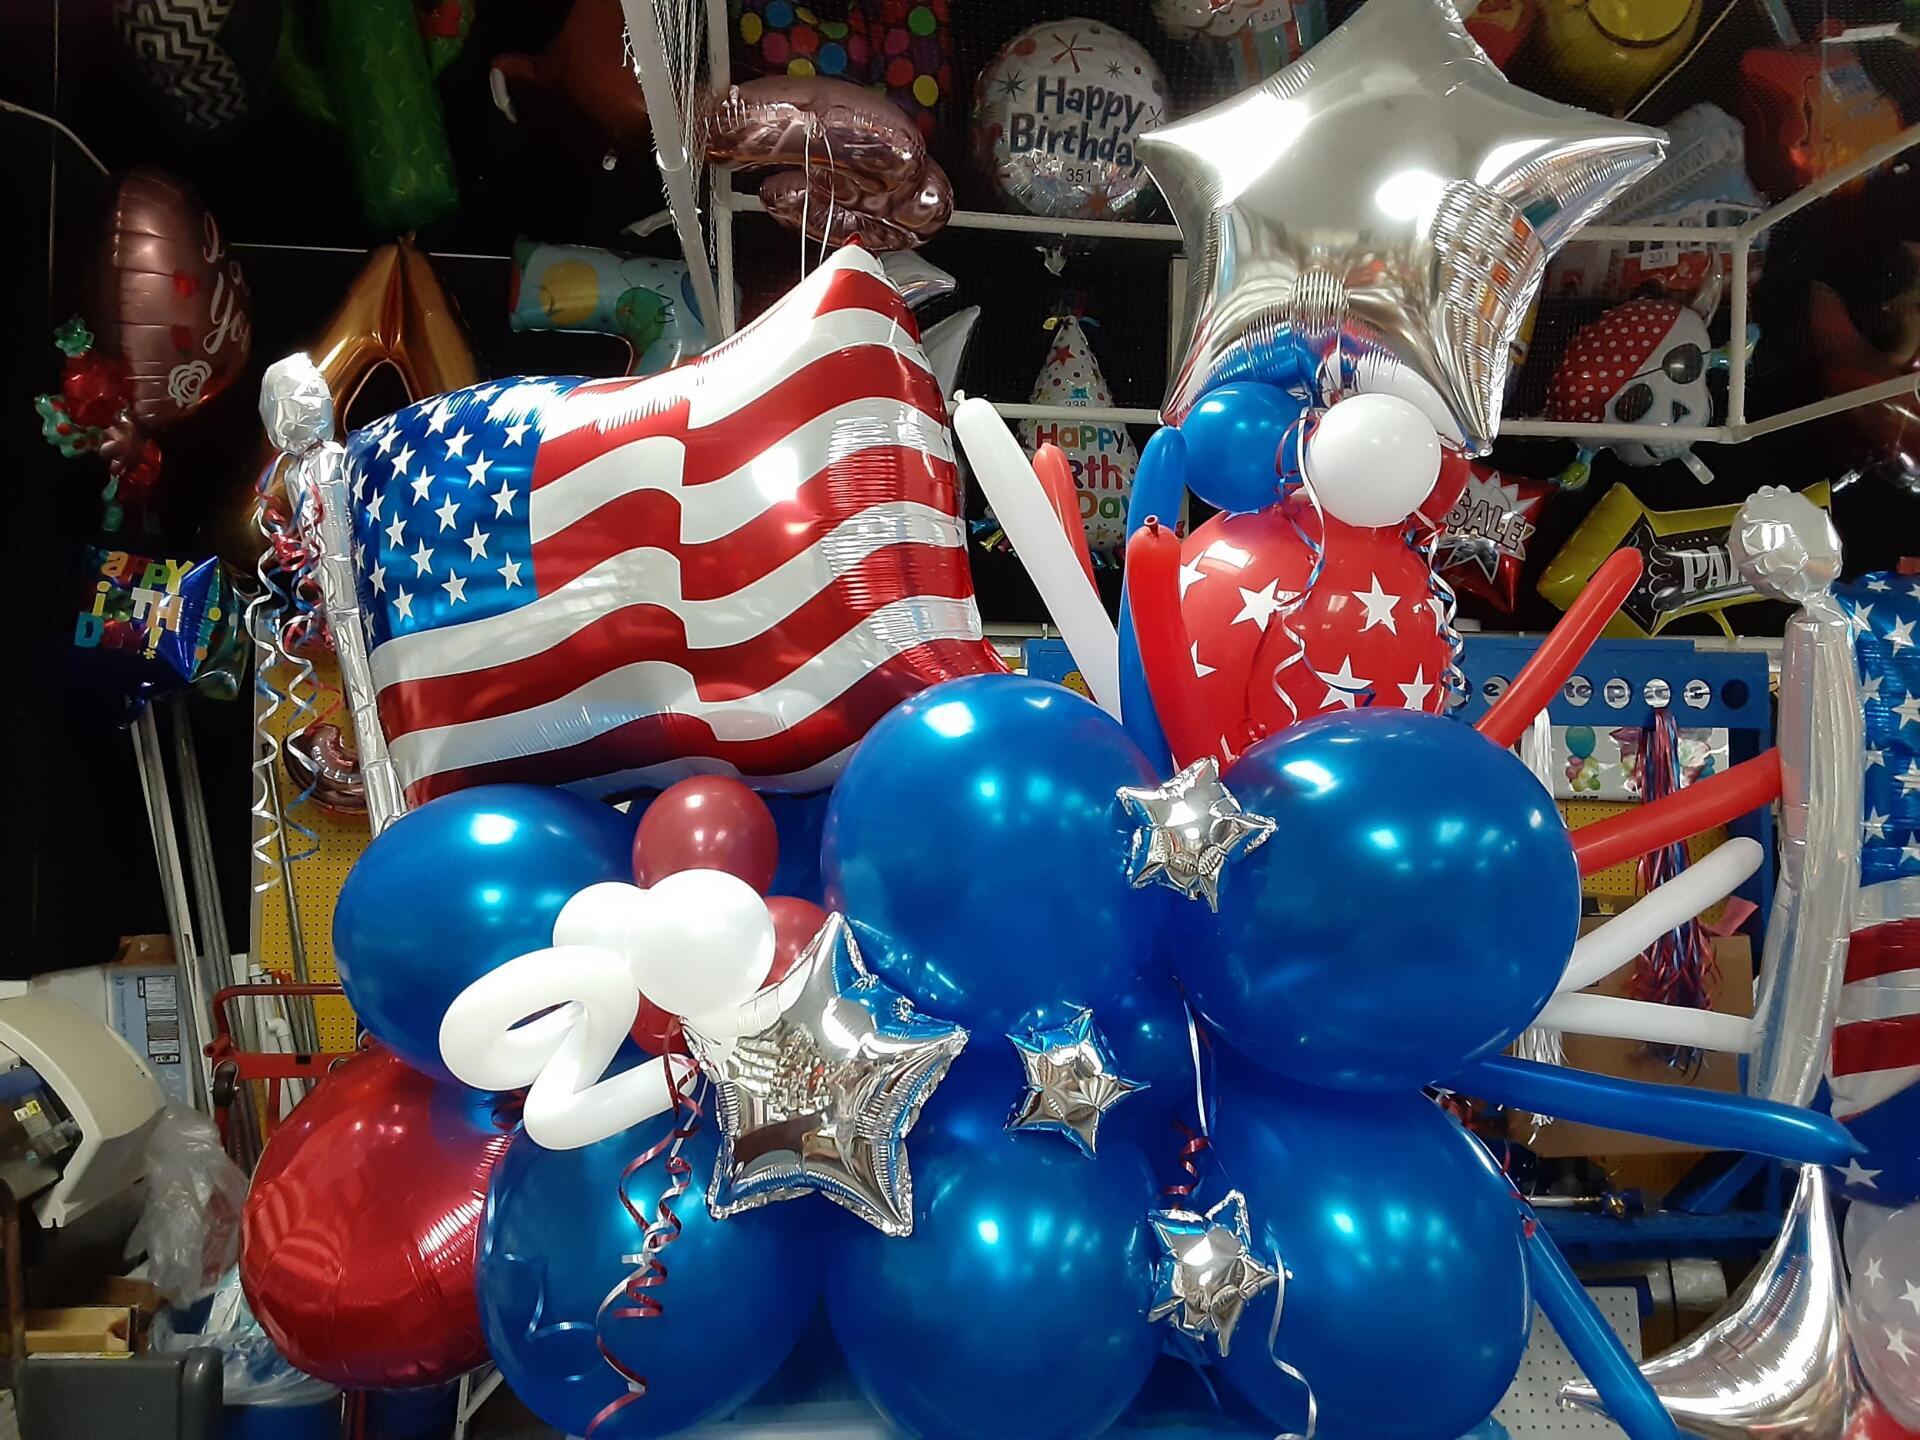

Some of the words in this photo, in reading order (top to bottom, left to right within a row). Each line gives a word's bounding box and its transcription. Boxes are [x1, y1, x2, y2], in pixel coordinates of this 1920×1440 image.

[1036, 75, 1146, 134] Happy
[1065, 167, 1093, 184] 351
[1036, 423, 1124, 454] Happy
